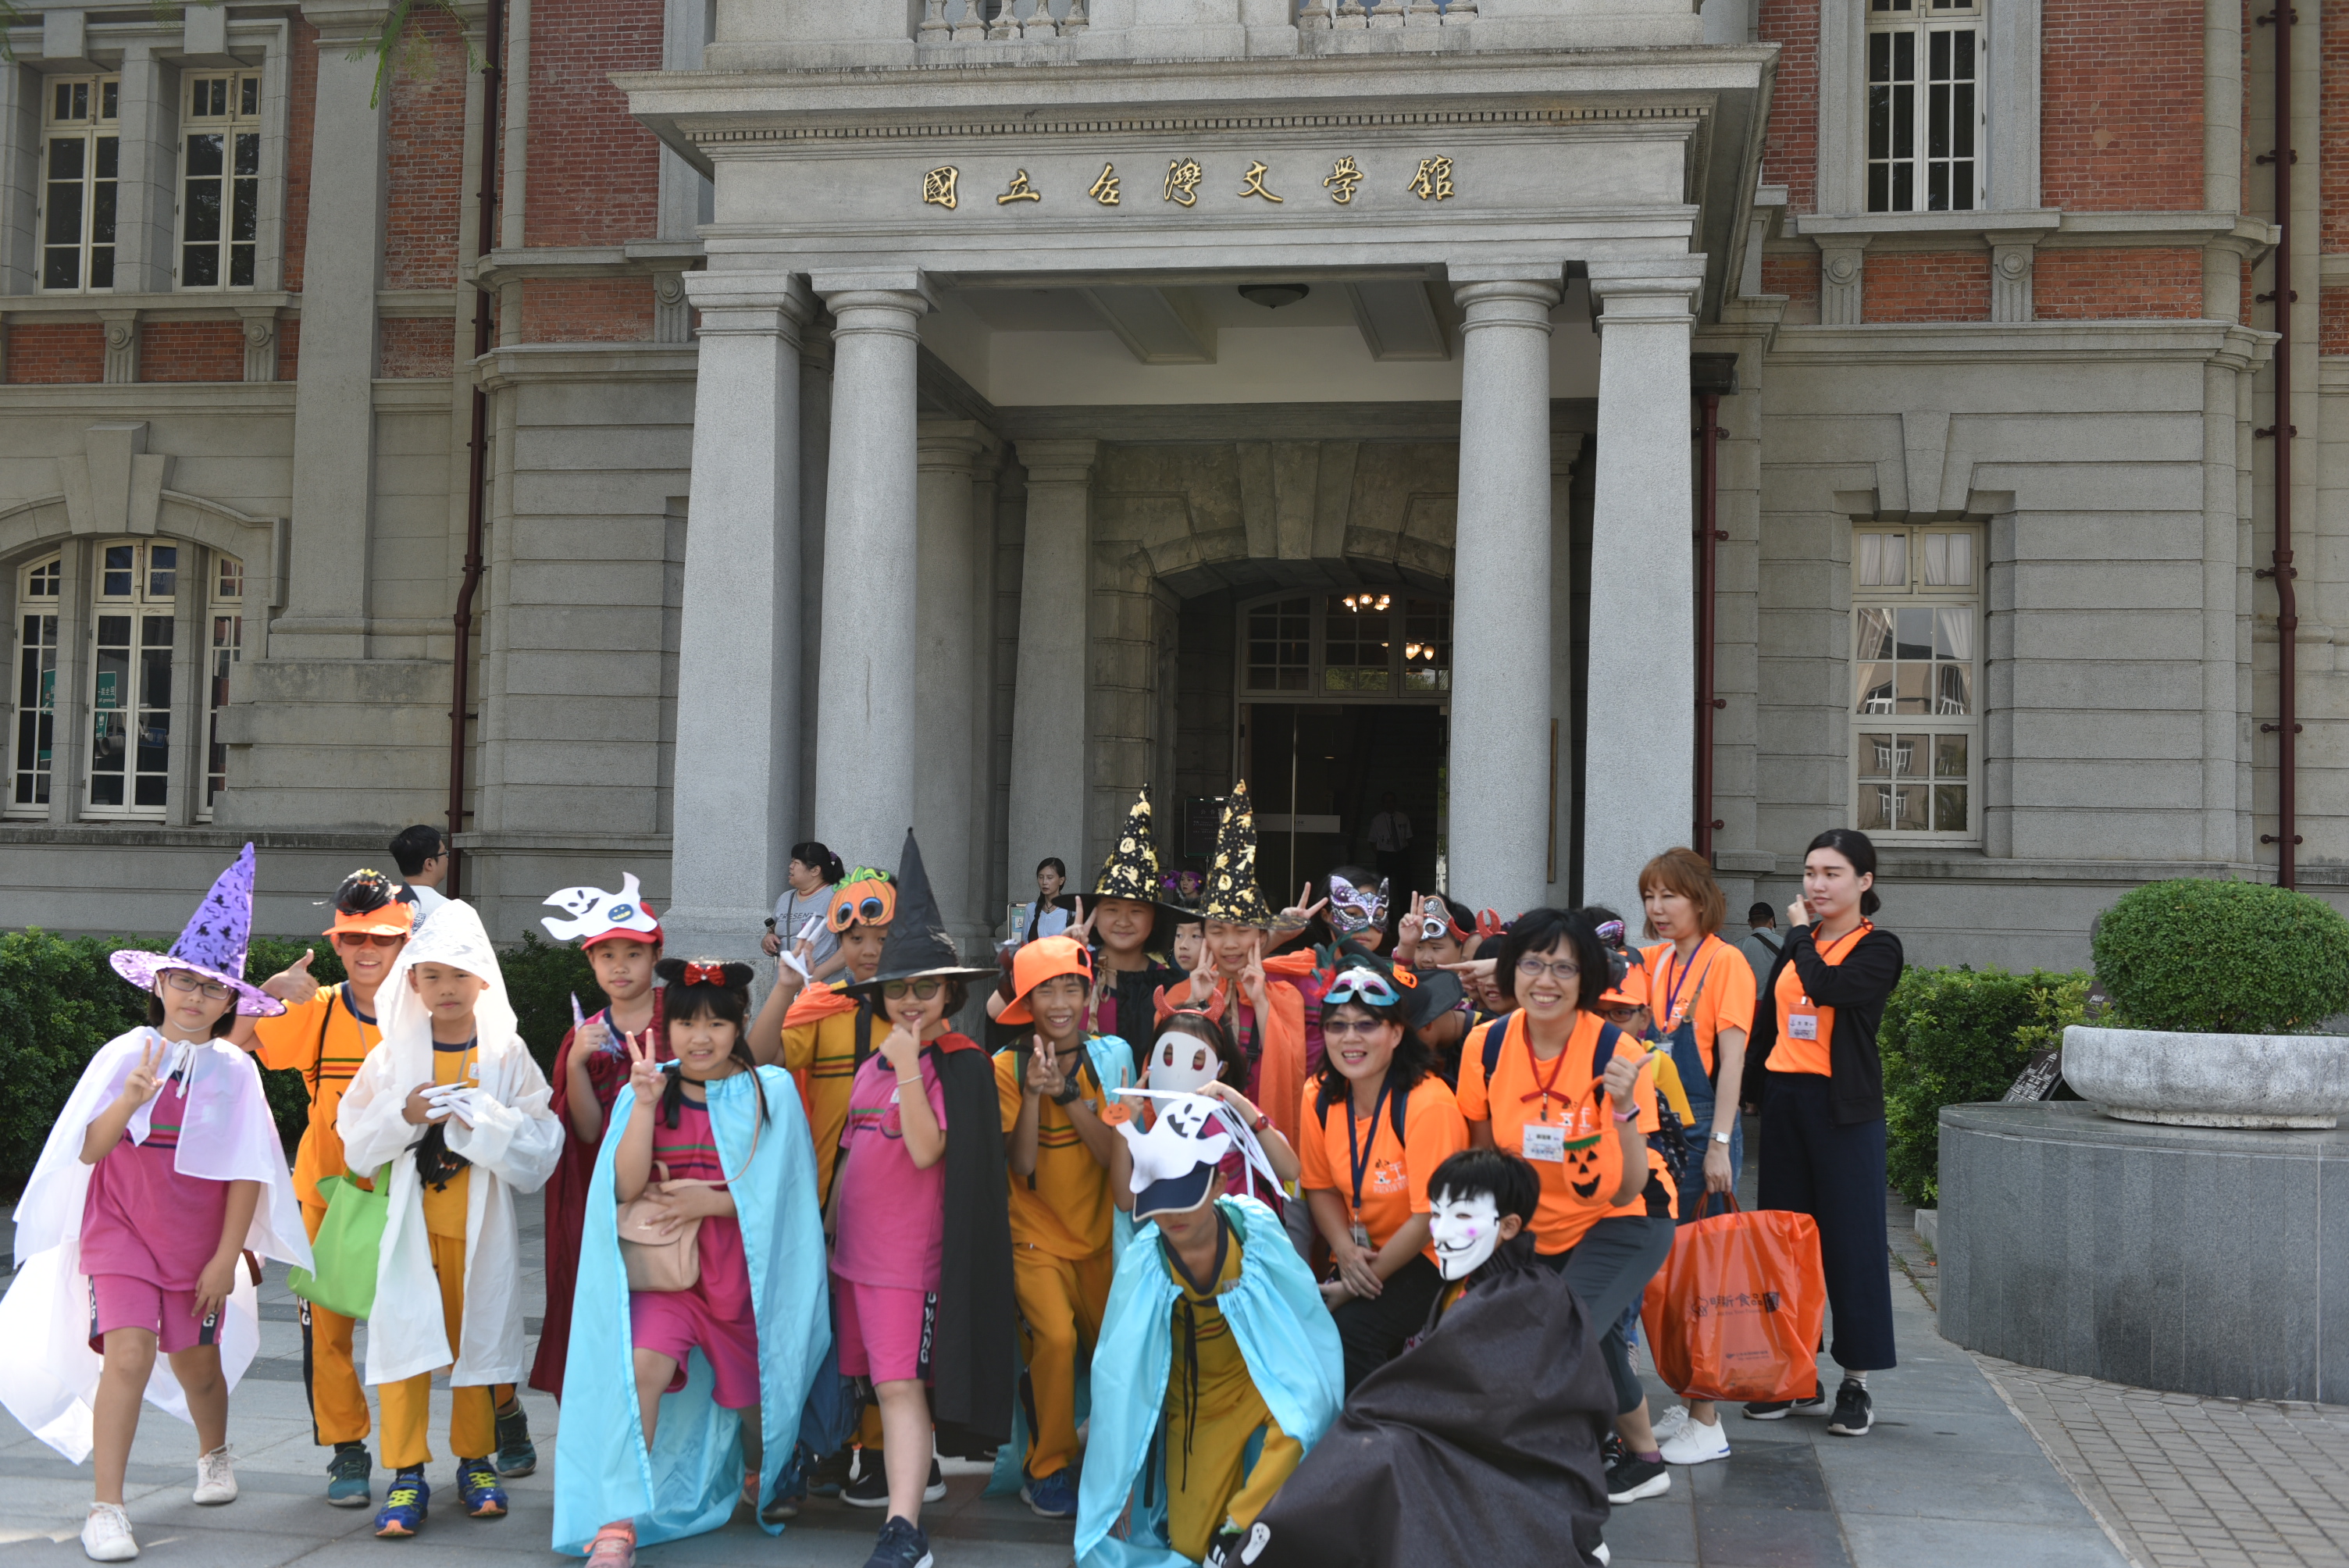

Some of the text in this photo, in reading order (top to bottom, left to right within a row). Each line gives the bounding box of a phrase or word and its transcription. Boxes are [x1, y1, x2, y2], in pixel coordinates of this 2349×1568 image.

[923, 155, 1454, 208] 國立台灣文學館
